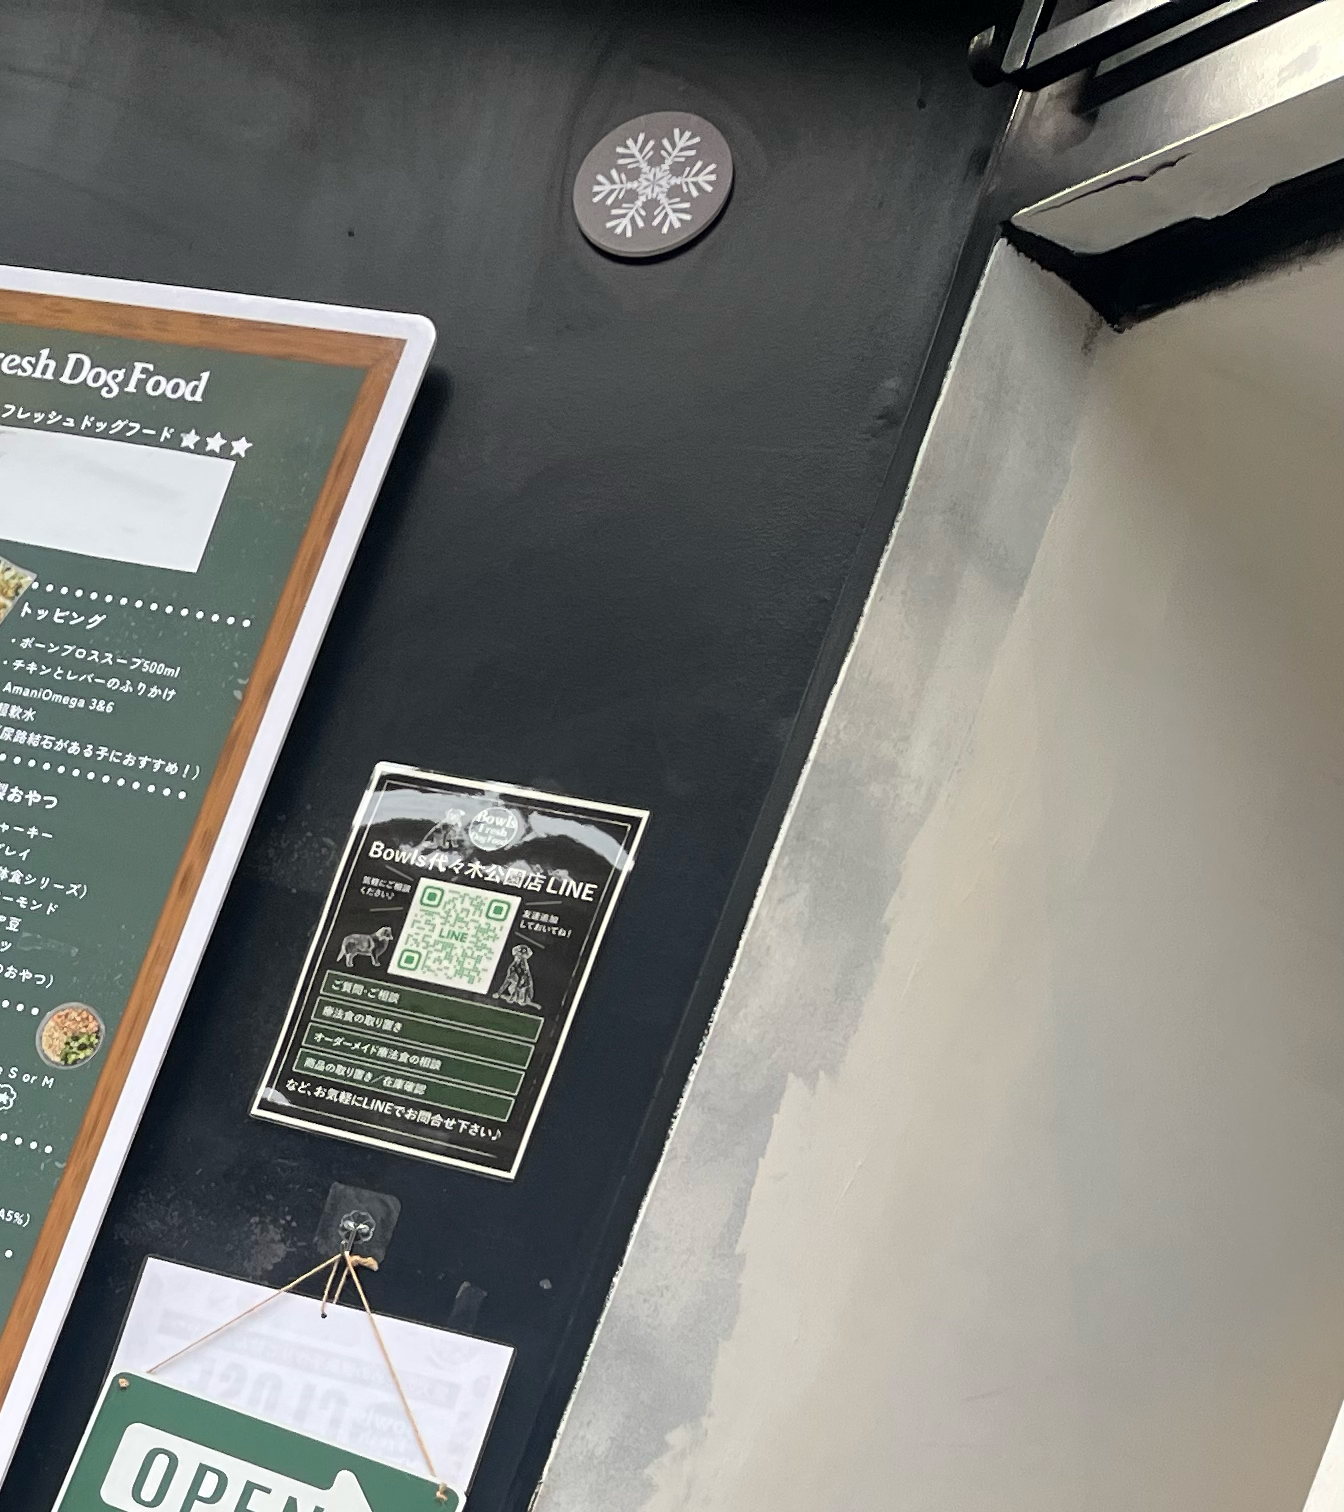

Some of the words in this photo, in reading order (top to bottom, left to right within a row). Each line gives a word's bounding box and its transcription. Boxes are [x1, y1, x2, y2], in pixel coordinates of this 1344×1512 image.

[59, 353, 126, 398] Dog
[124, 362, 210, 401] Food
[21, 602, 106, 629] トッピング
[13, 660, 176, 701] チキンとレバーのふりかけ
[2, 682, 85, 708] AmaniOmega
[89, 699, 114, 713] 3&6
[439, 928, 468, 942] LINE
[8, 1067, 18, 1078] S
[23, 1074, 37, 1083] or
[42, 1076, 54, 1088] M
